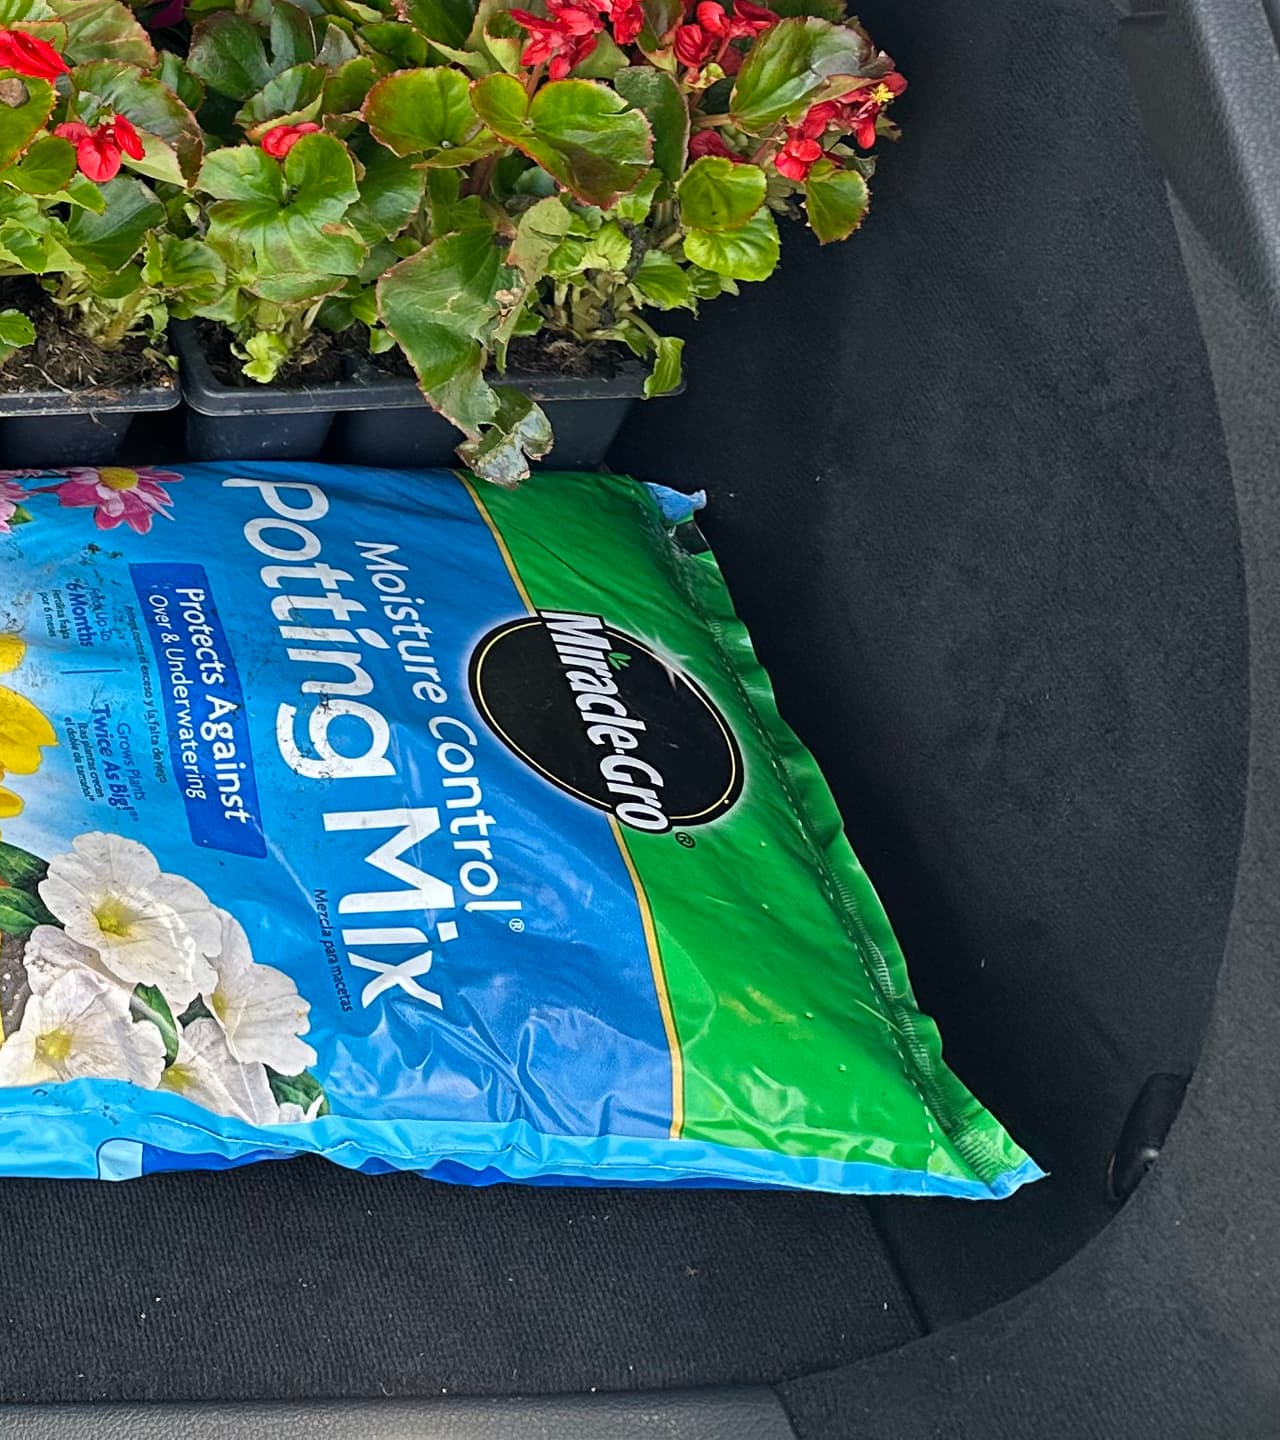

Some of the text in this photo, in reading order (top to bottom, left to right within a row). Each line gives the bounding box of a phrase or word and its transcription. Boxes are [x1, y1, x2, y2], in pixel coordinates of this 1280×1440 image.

[37, 592, 49, 605] por
[66, 583, 98, 647] 6 Months
[94, 612, 109, 627] Up
[353, 541, 448, 704] Moisture
[100, 629, 113, 641] To
[140, 665, 153, 698] exceso
[148, 594, 207, 800] Over & Underwatering
[175, 588, 252, 824] Protects Against
[64, 717, 75, 725] el
[145, 709, 157, 719] la
[66, 727, 81, 750] doble
[91, 704, 114, 757] Twice
[147, 720, 161, 745] falta
[152, 747, 165, 760] de
[221, 477, 458, 1011] Potting Mix
[73, 752, 85, 763] de
[102, 760, 121, 780] As
[116, 723, 146, 800] Grows Plants
[314, 888, 353, 1013] Mezcla para macetas
